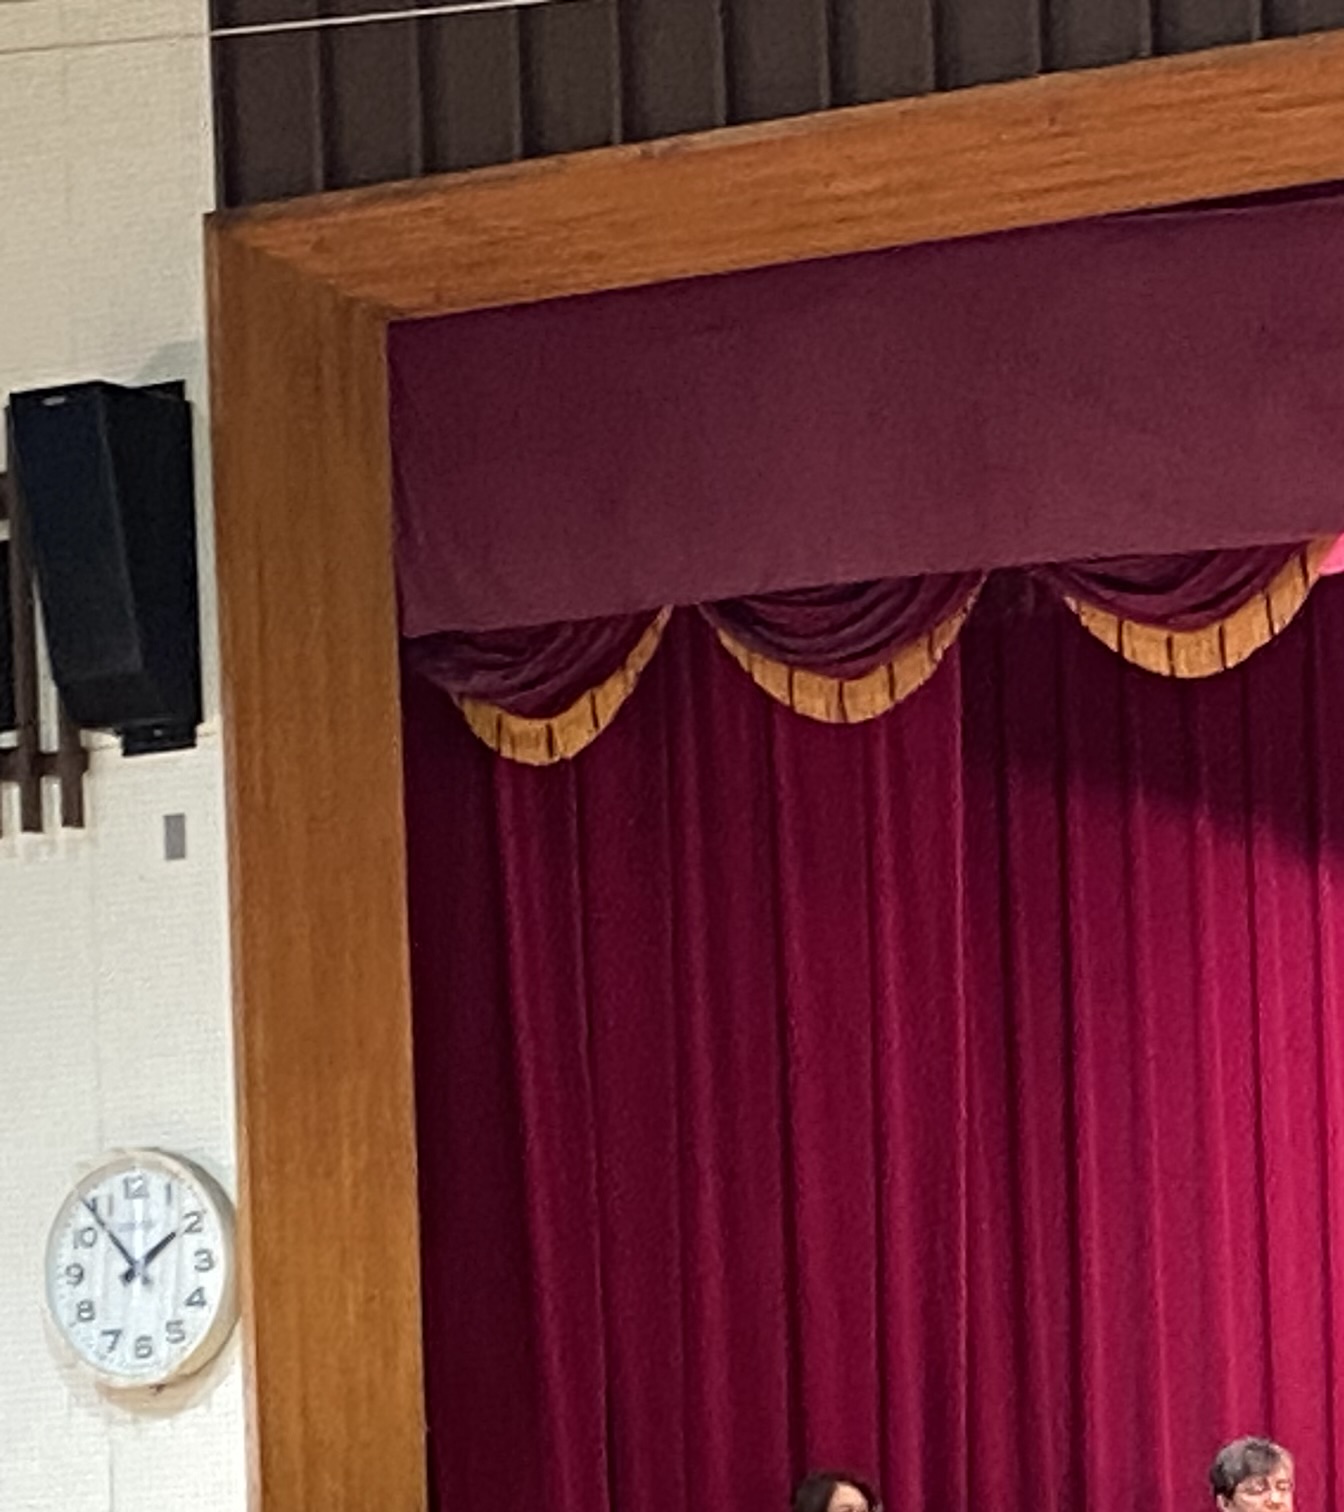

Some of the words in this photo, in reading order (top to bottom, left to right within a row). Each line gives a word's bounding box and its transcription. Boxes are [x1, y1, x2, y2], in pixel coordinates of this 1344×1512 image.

[123, 1174, 149, 1200] 12
[182, 1210, 204, 1234] 2
[73, 1227, 98, 1250] 10
[194, 1249, 215, 1273] 3
[65, 1262, 85, 1287] 9
[185, 1286, 207, 1309] 4
[76, 1299, 96, 1323] 8
[101, 1328, 123, 1354] 7
[165, 1319, 186, 1344] 5
[134, 1335, 153, 1359] 6
